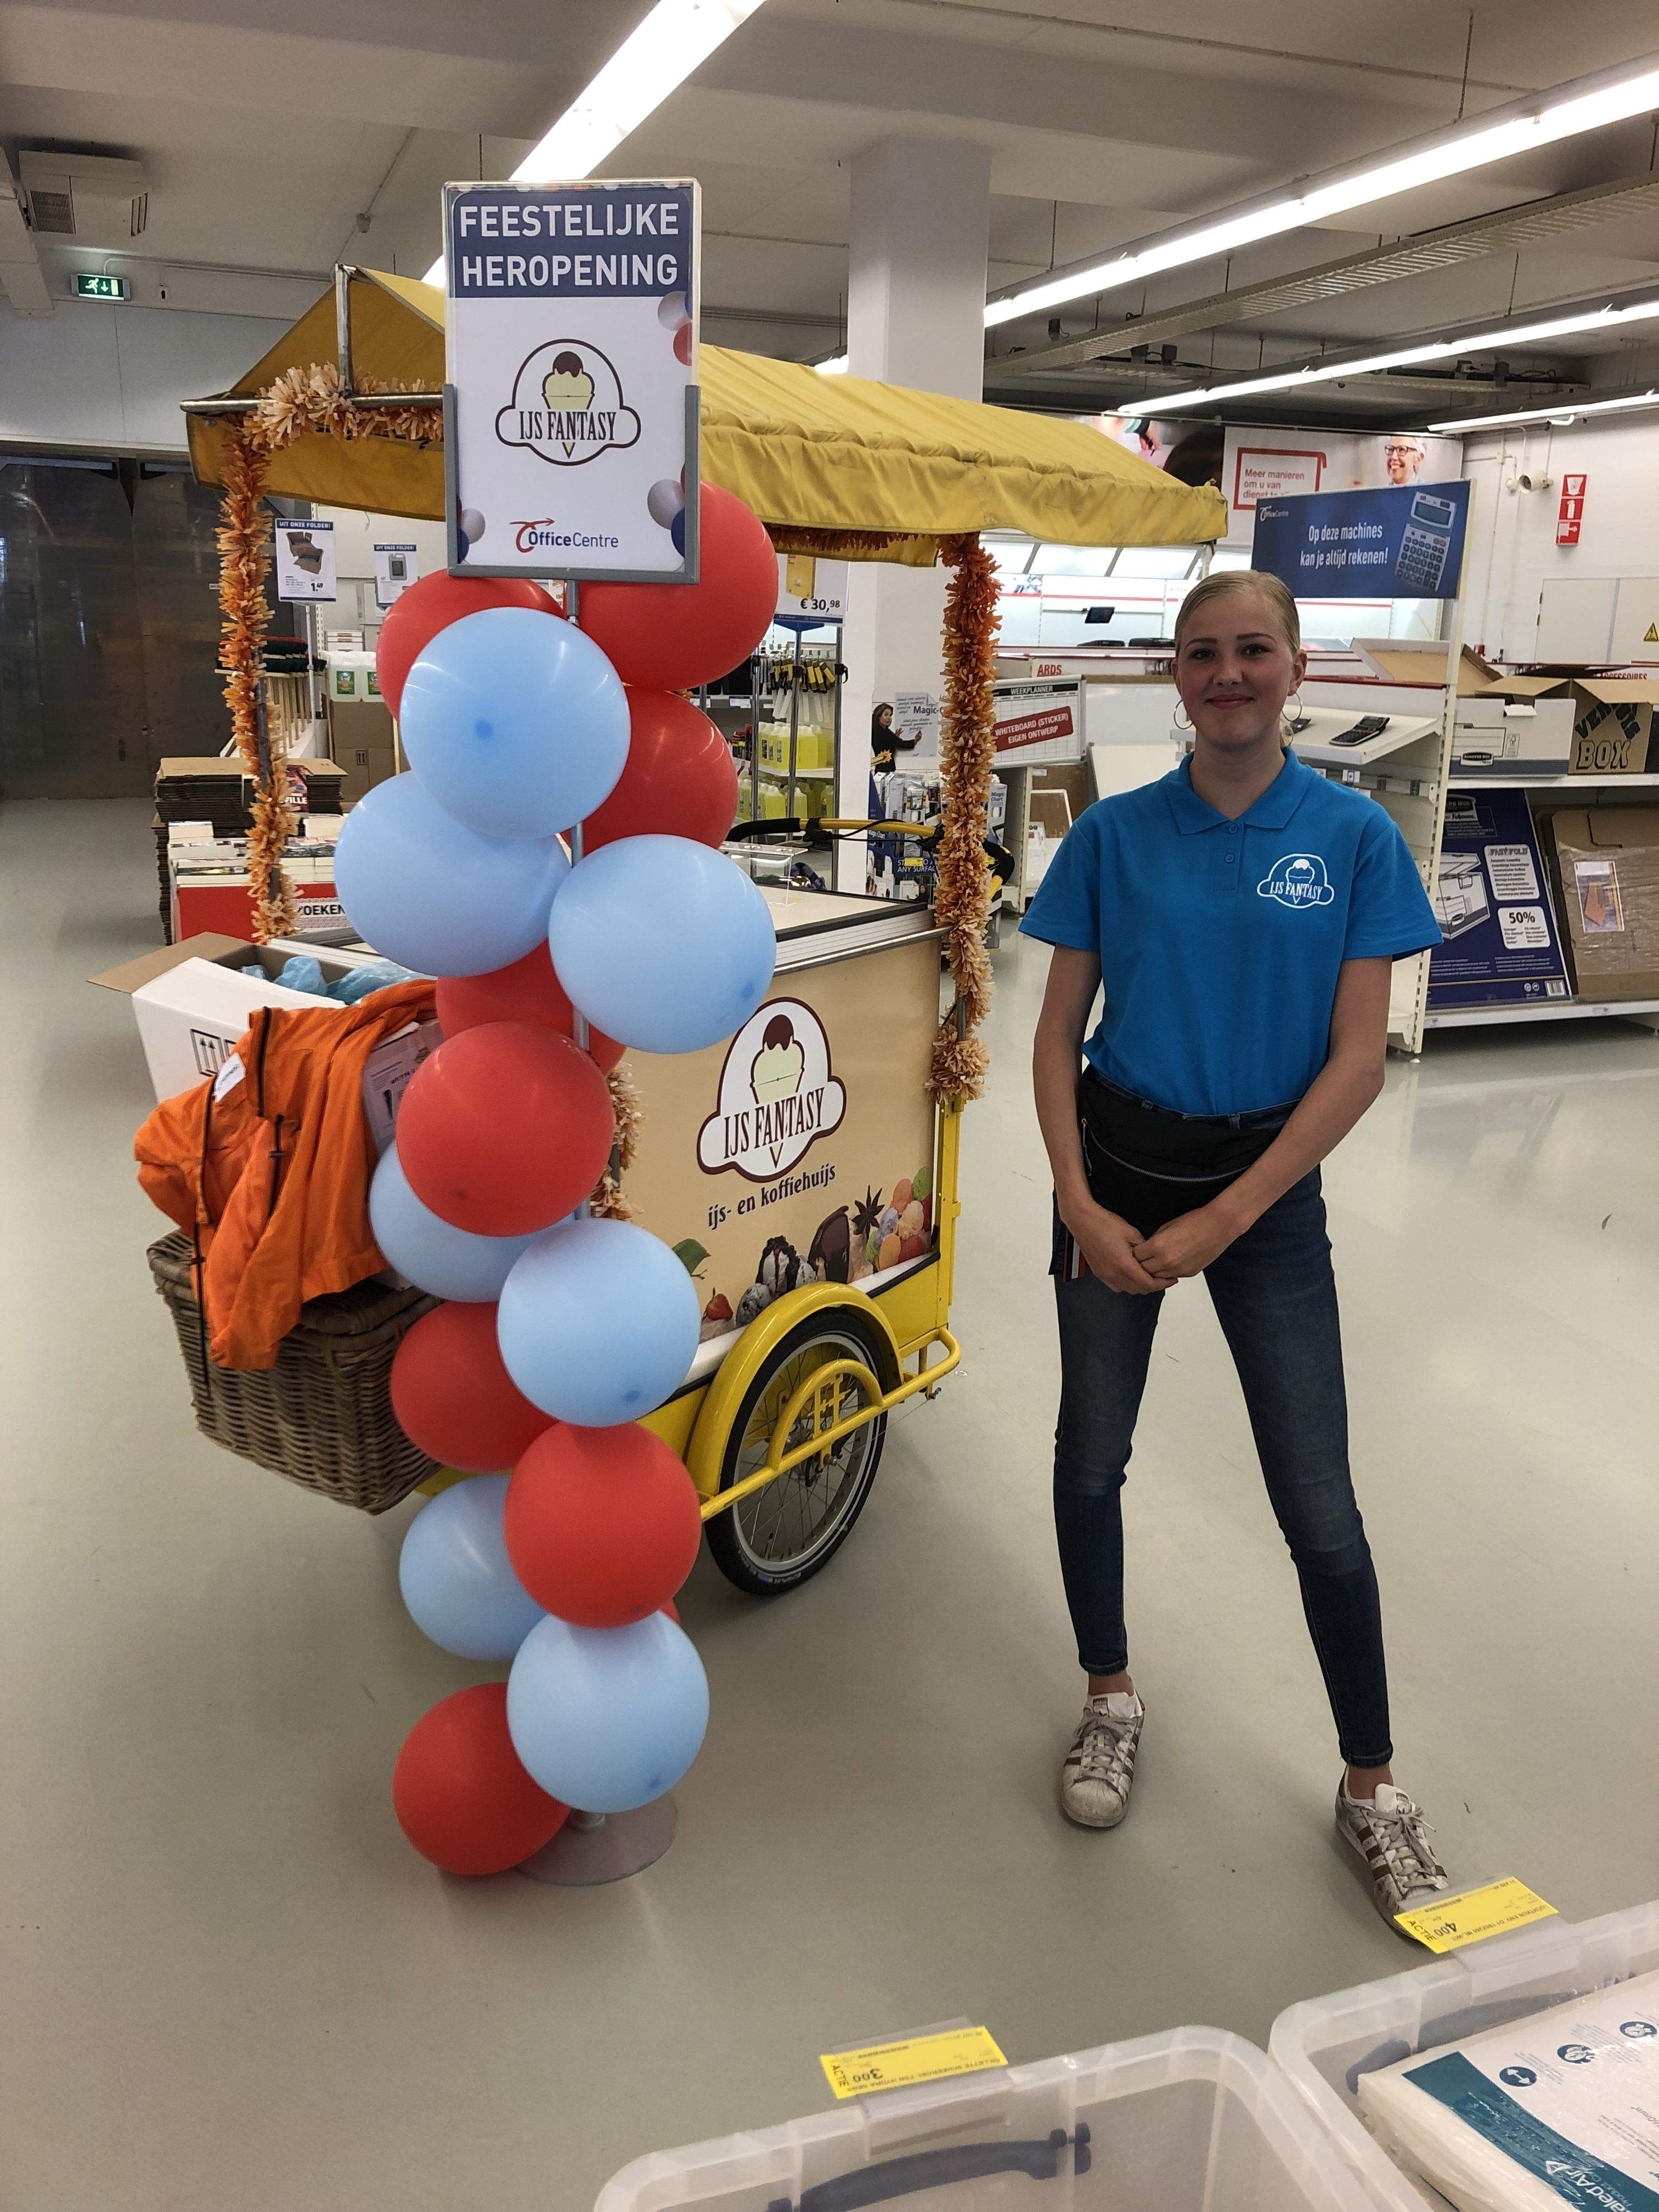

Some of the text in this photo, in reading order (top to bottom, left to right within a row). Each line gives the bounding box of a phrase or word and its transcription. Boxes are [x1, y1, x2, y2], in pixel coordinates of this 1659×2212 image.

[460, 203, 679, 237] FEESTELIJKE
[462, 253, 678, 287] HEROPENING
[519, 410, 617, 441] IJS FANTASY
[1245, 469, 1305, 480] Meer manieren
[528, 531, 619, 548] OfficeCentre
[1308, 522, 1383, 544] Op deze machines
[1300, 547, 1389, 569] kan je altijd rekenen!
[800, 598, 840, 613] € 30,98
[1011, 686, 1053, 695] WEEKPLANNER
[995, 713, 1069, 736] WHITEBOARD (STICKER)
[1008, 725, 1059, 744] EIGEN ONTWERP
[1576, 740, 1631, 769] BOX
[1269, 882, 1323, 900] IJS FANTASY
[1509, 911, 1536, 924] 50%
[724, 1086, 825, 1159] IJS FANTASY
[708, 1164, 836, 1230] ijs- en koffiehuijs
